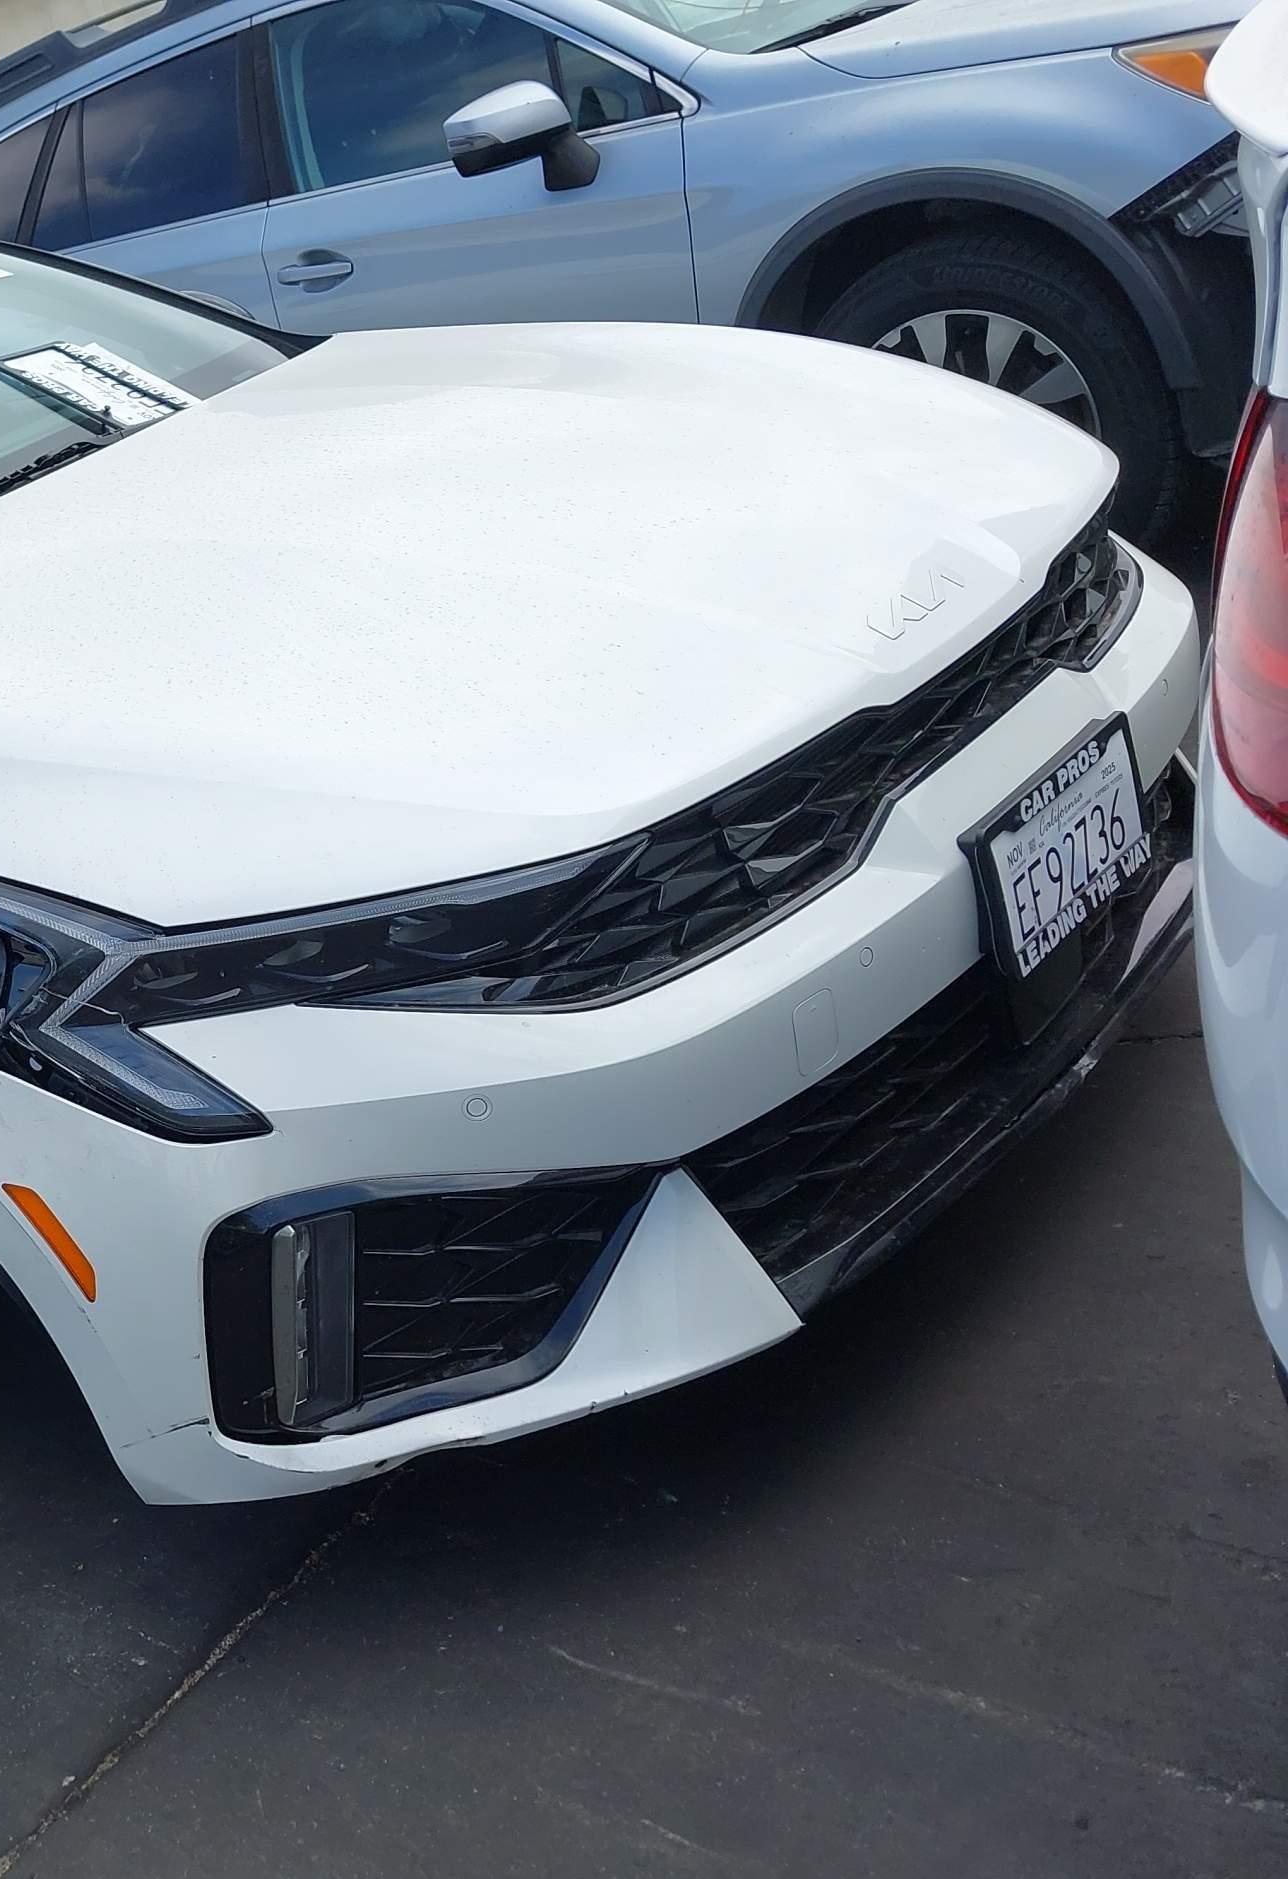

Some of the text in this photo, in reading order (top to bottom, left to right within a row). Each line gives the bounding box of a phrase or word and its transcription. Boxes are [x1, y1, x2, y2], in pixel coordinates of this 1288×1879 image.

[1018, 780, 1055, 822] CAR
[1056, 740, 1100, 794] PROS
[1101, 762, 1116, 780] 2025
[1040, 792, 1083, 836] California
[1007, 841, 1023, 869] NOV
[1013, 787, 1126, 941] EF92736
[1015, 832, 1153, 979] LEADING THE WAY
